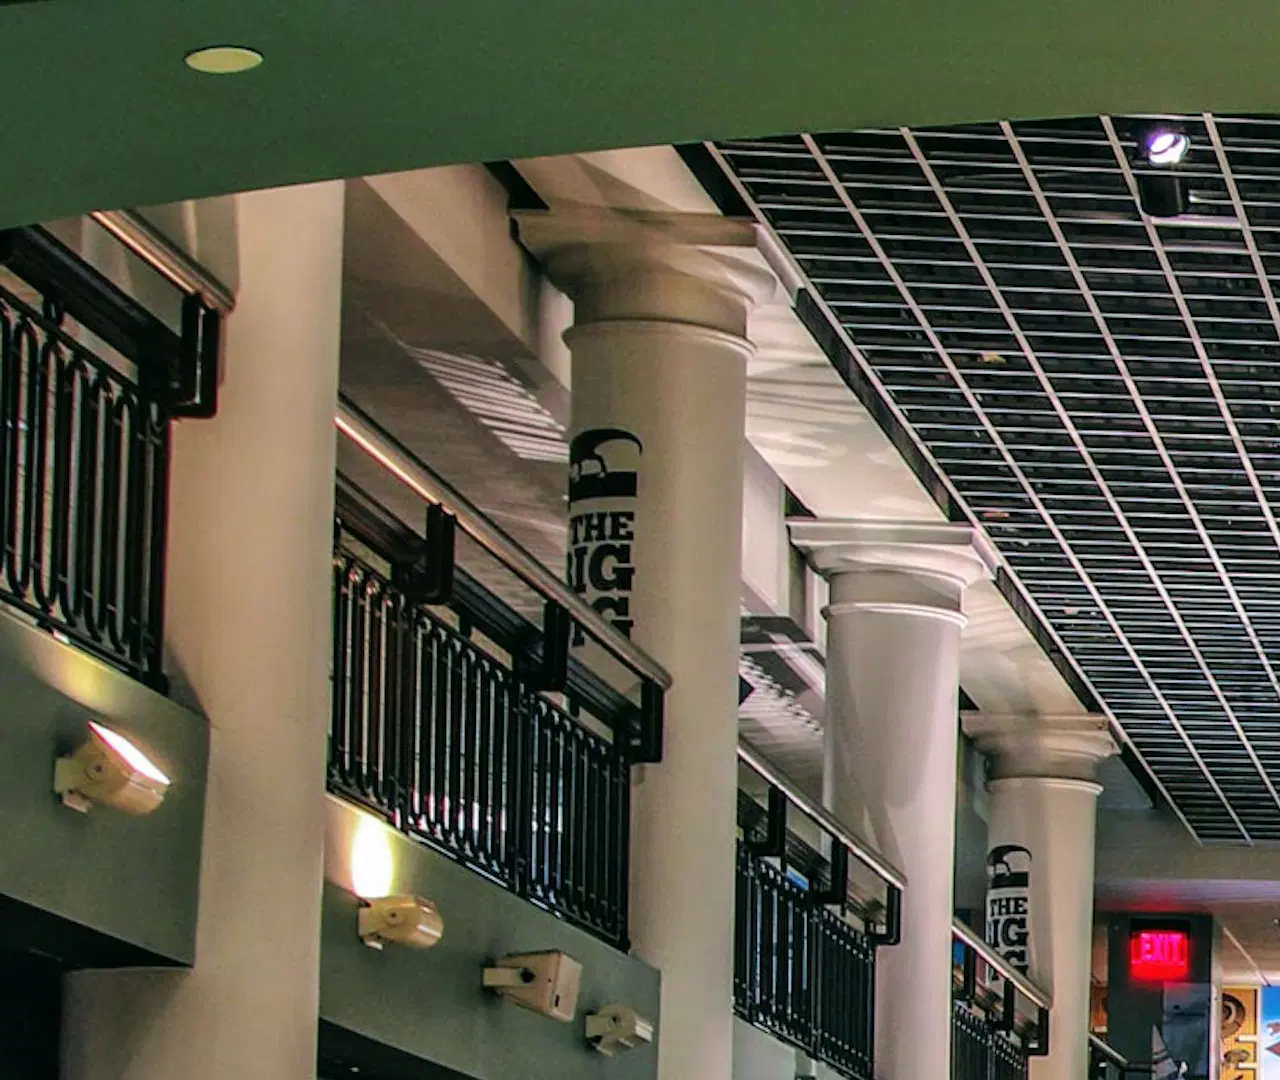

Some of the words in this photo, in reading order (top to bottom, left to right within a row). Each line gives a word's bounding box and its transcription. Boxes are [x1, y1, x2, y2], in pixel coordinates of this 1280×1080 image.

[570, 511, 635, 545] THE
[567, 543, 636, 594] IG
[989, 896, 1029, 917] THE
[986, 917, 1029, 948] IG
[1140, 932, 1183, 962] EXIT
